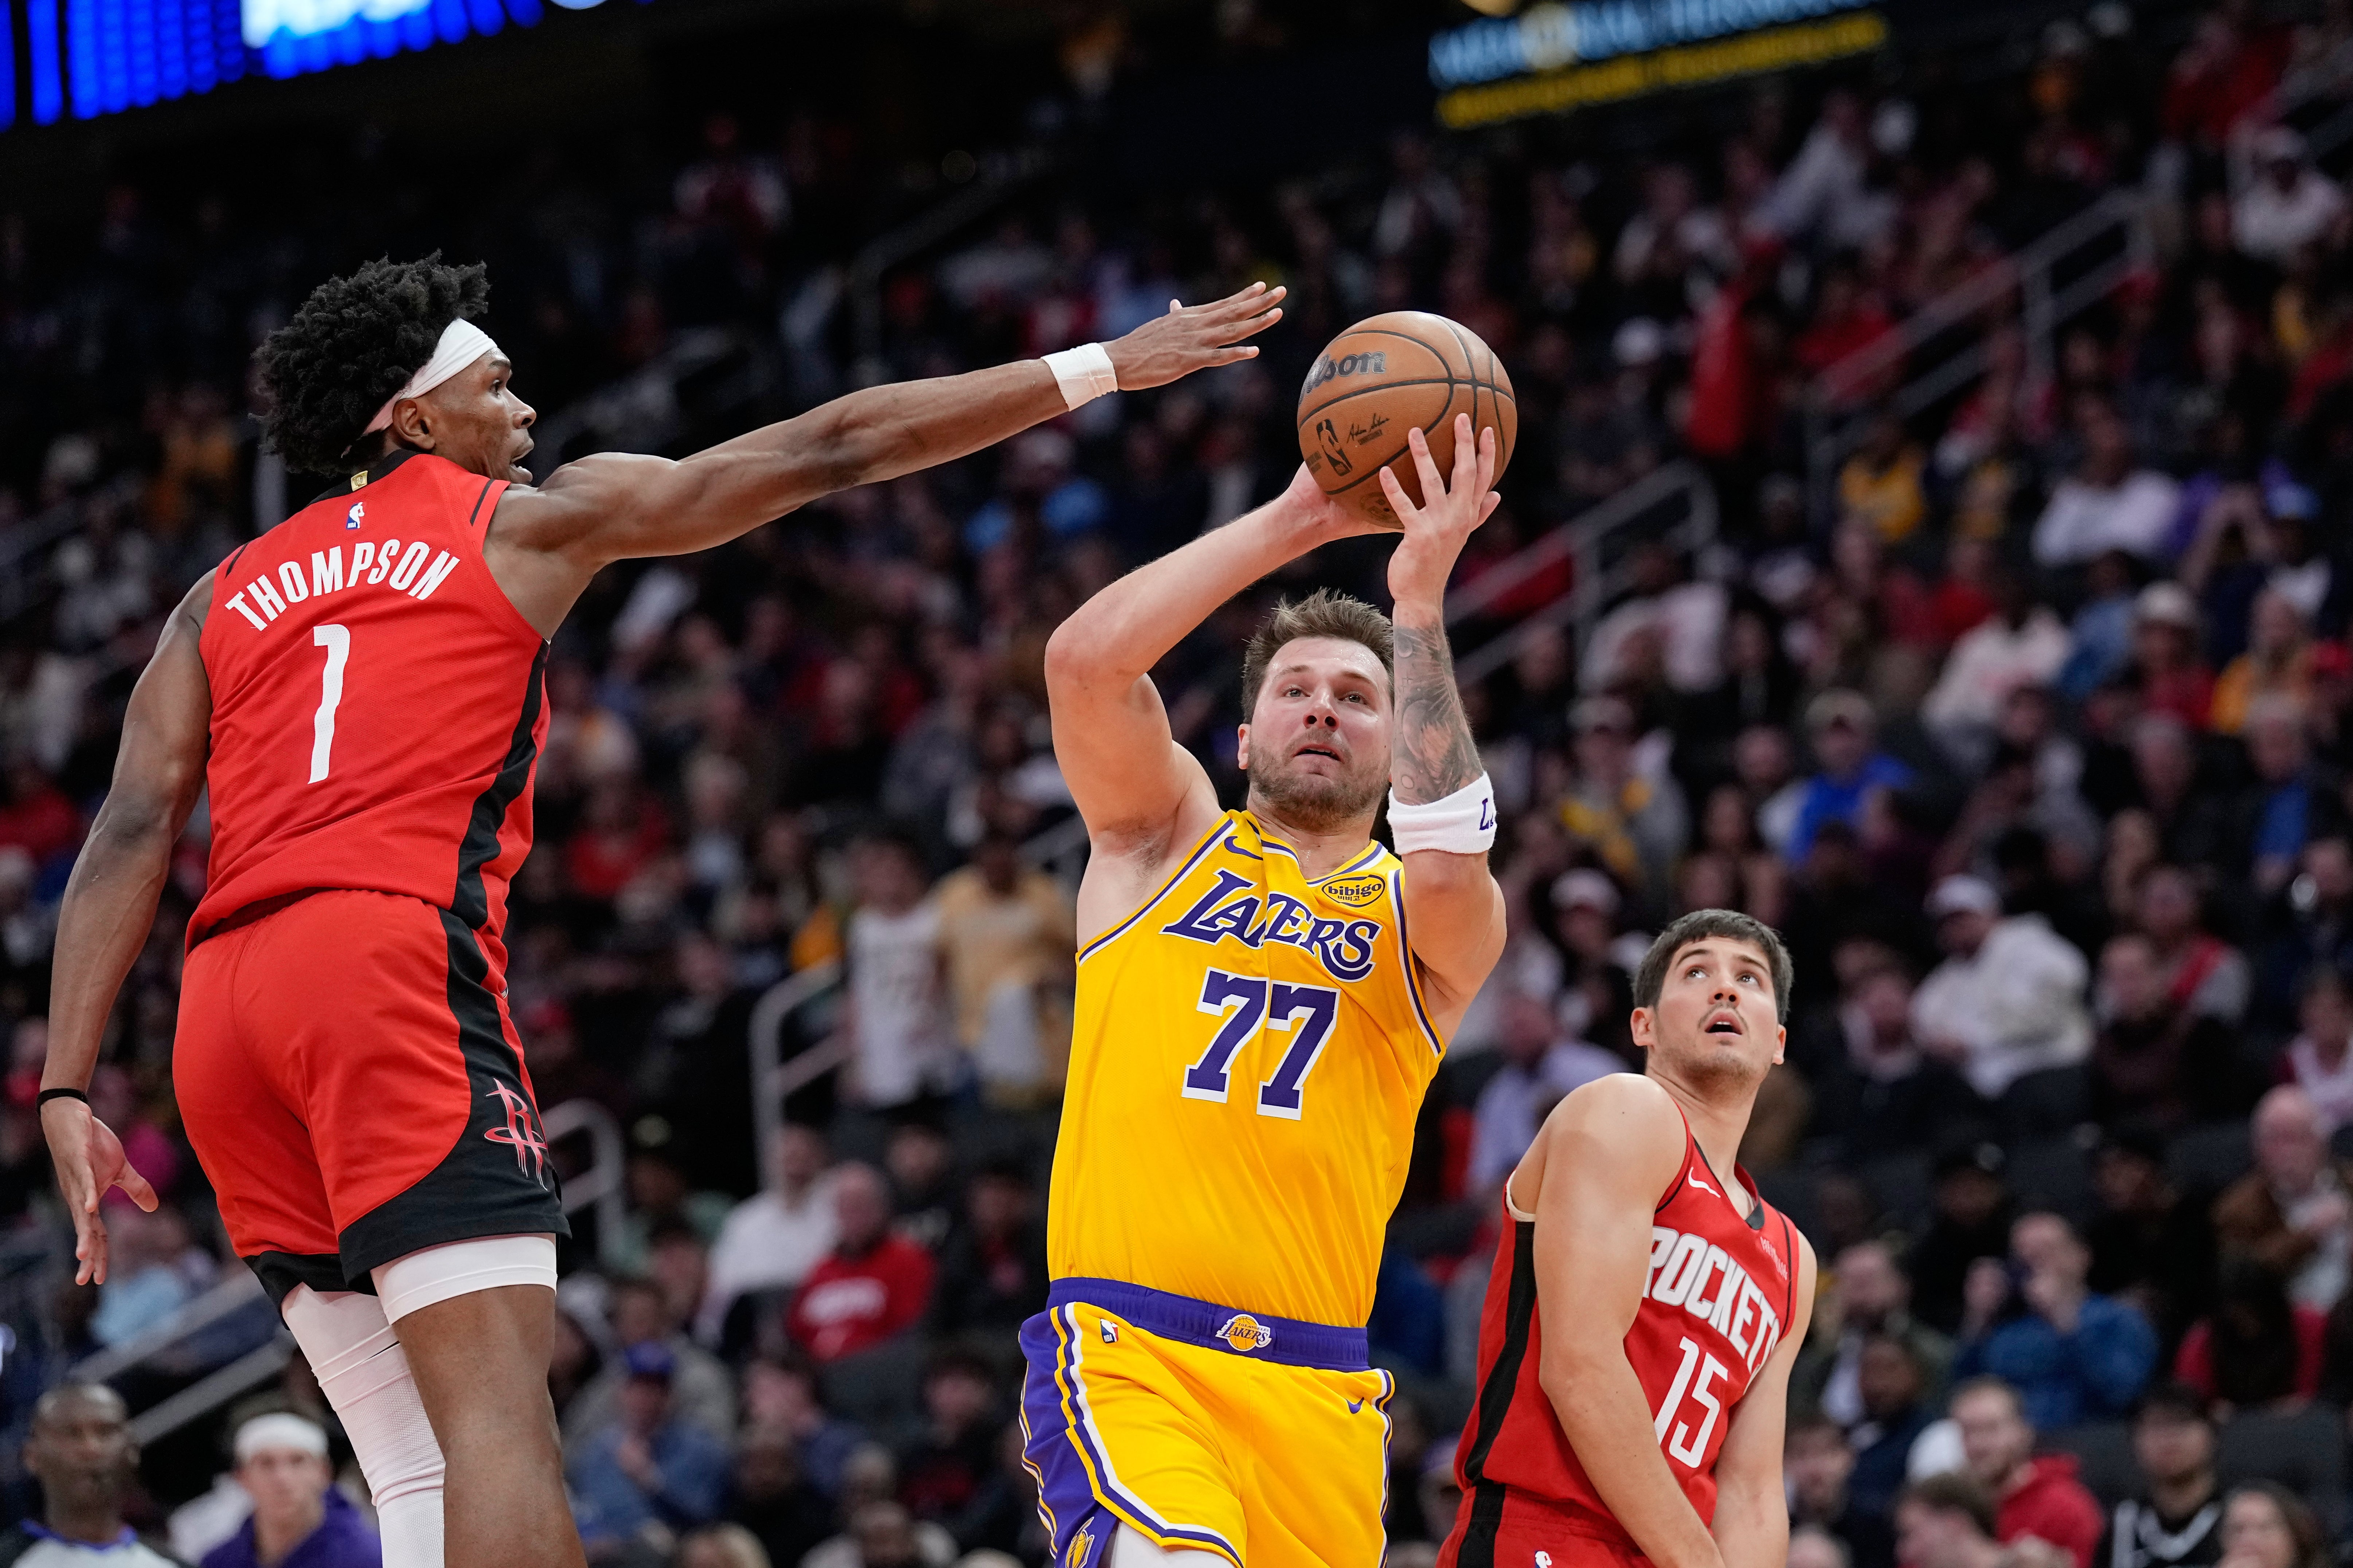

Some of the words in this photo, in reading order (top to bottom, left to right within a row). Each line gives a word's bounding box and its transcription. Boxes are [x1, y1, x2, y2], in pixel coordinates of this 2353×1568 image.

[225, 539, 460, 631] THOMPSON
[308, 624, 350, 784] 1
[1328, 883, 1382, 897] bibigo
[1181, 967, 1341, 1121] 77
[1103, 1334, 1113, 1342] NBA
[1222, 1321, 1269, 1345] LAKERS
[1654, 1336, 1728, 1469] 15
